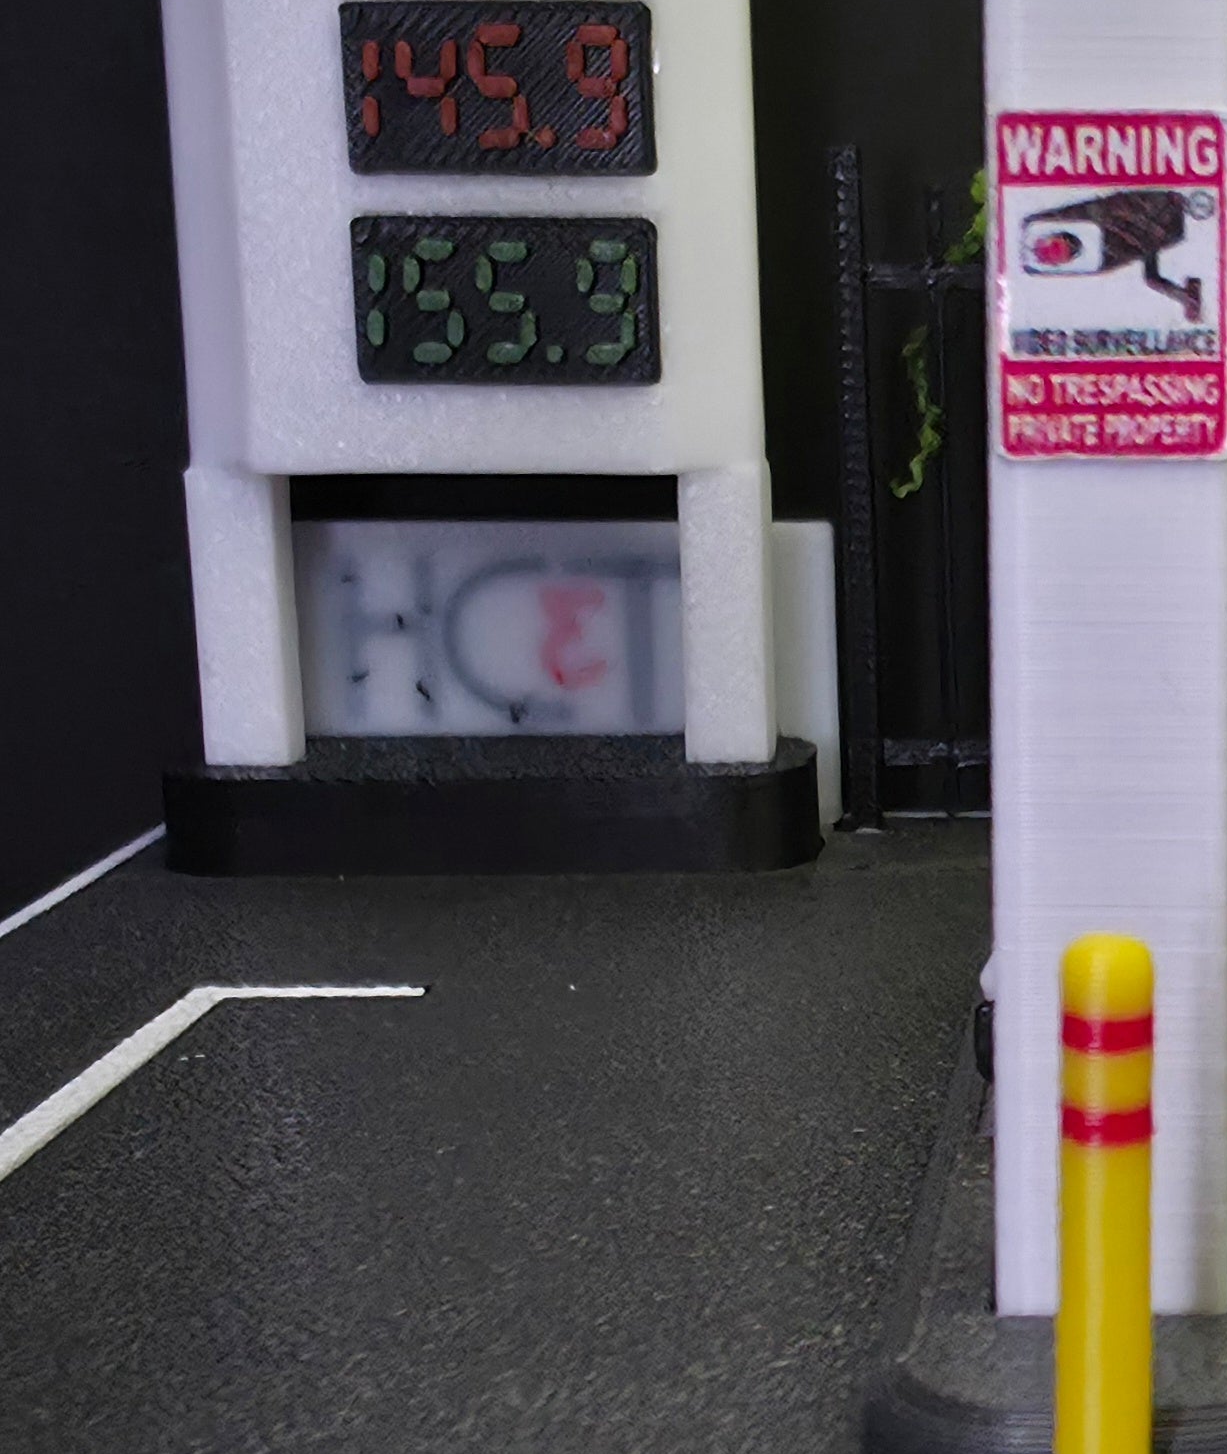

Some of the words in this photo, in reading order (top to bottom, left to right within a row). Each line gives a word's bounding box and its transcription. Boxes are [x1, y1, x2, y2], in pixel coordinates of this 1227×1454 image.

[361, 23, 629, 151] 145.9
[1002, 124, 1220, 177] WARNING
[366, 238, 640, 367] 155.9
[1006, 373, 1046, 406] NO
[1049, 373, 1220, 407] TRESPASSING
[1007, 412, 1099, 446] PRIVATE
[1103, 412, 1219, 446] PROPERTY
